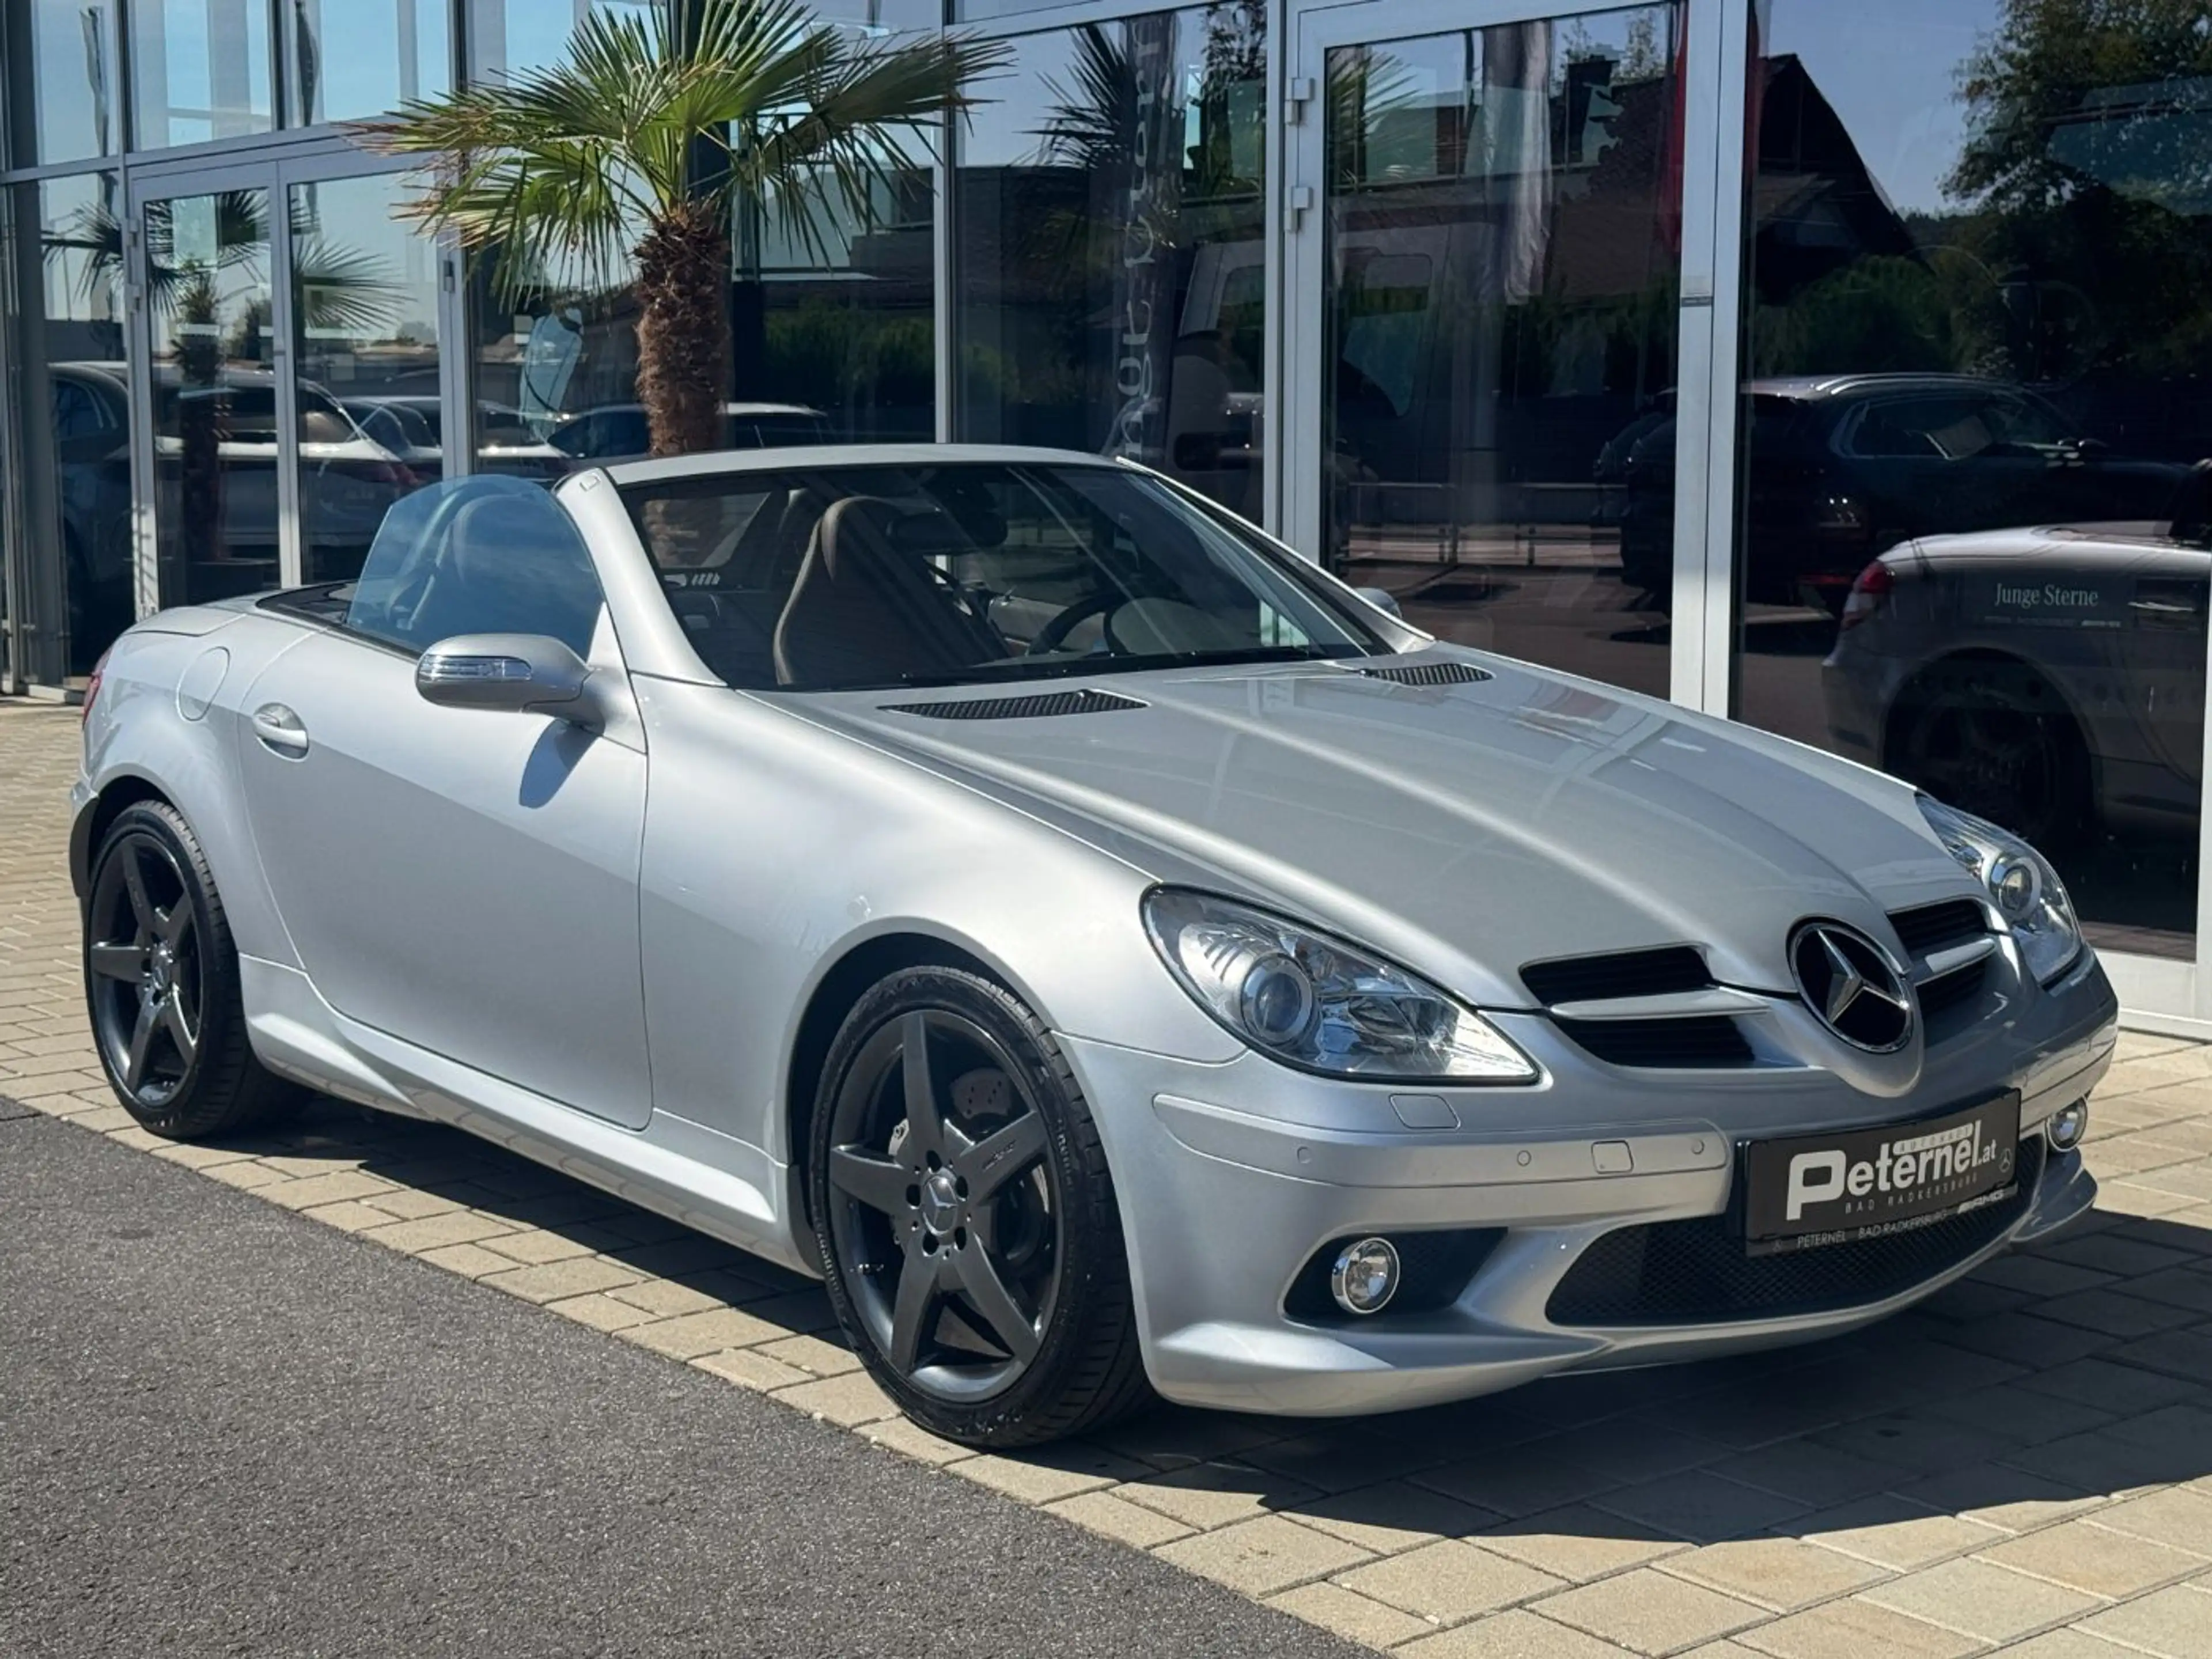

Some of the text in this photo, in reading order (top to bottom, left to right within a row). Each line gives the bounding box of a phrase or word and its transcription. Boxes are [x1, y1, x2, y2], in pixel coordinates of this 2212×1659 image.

[1994, 582, 2099, 609] Junge Sterne
[1845, 1199, 1875, 1214] BAD
[1796, 1230, 1846, 1249] PETERNEL
